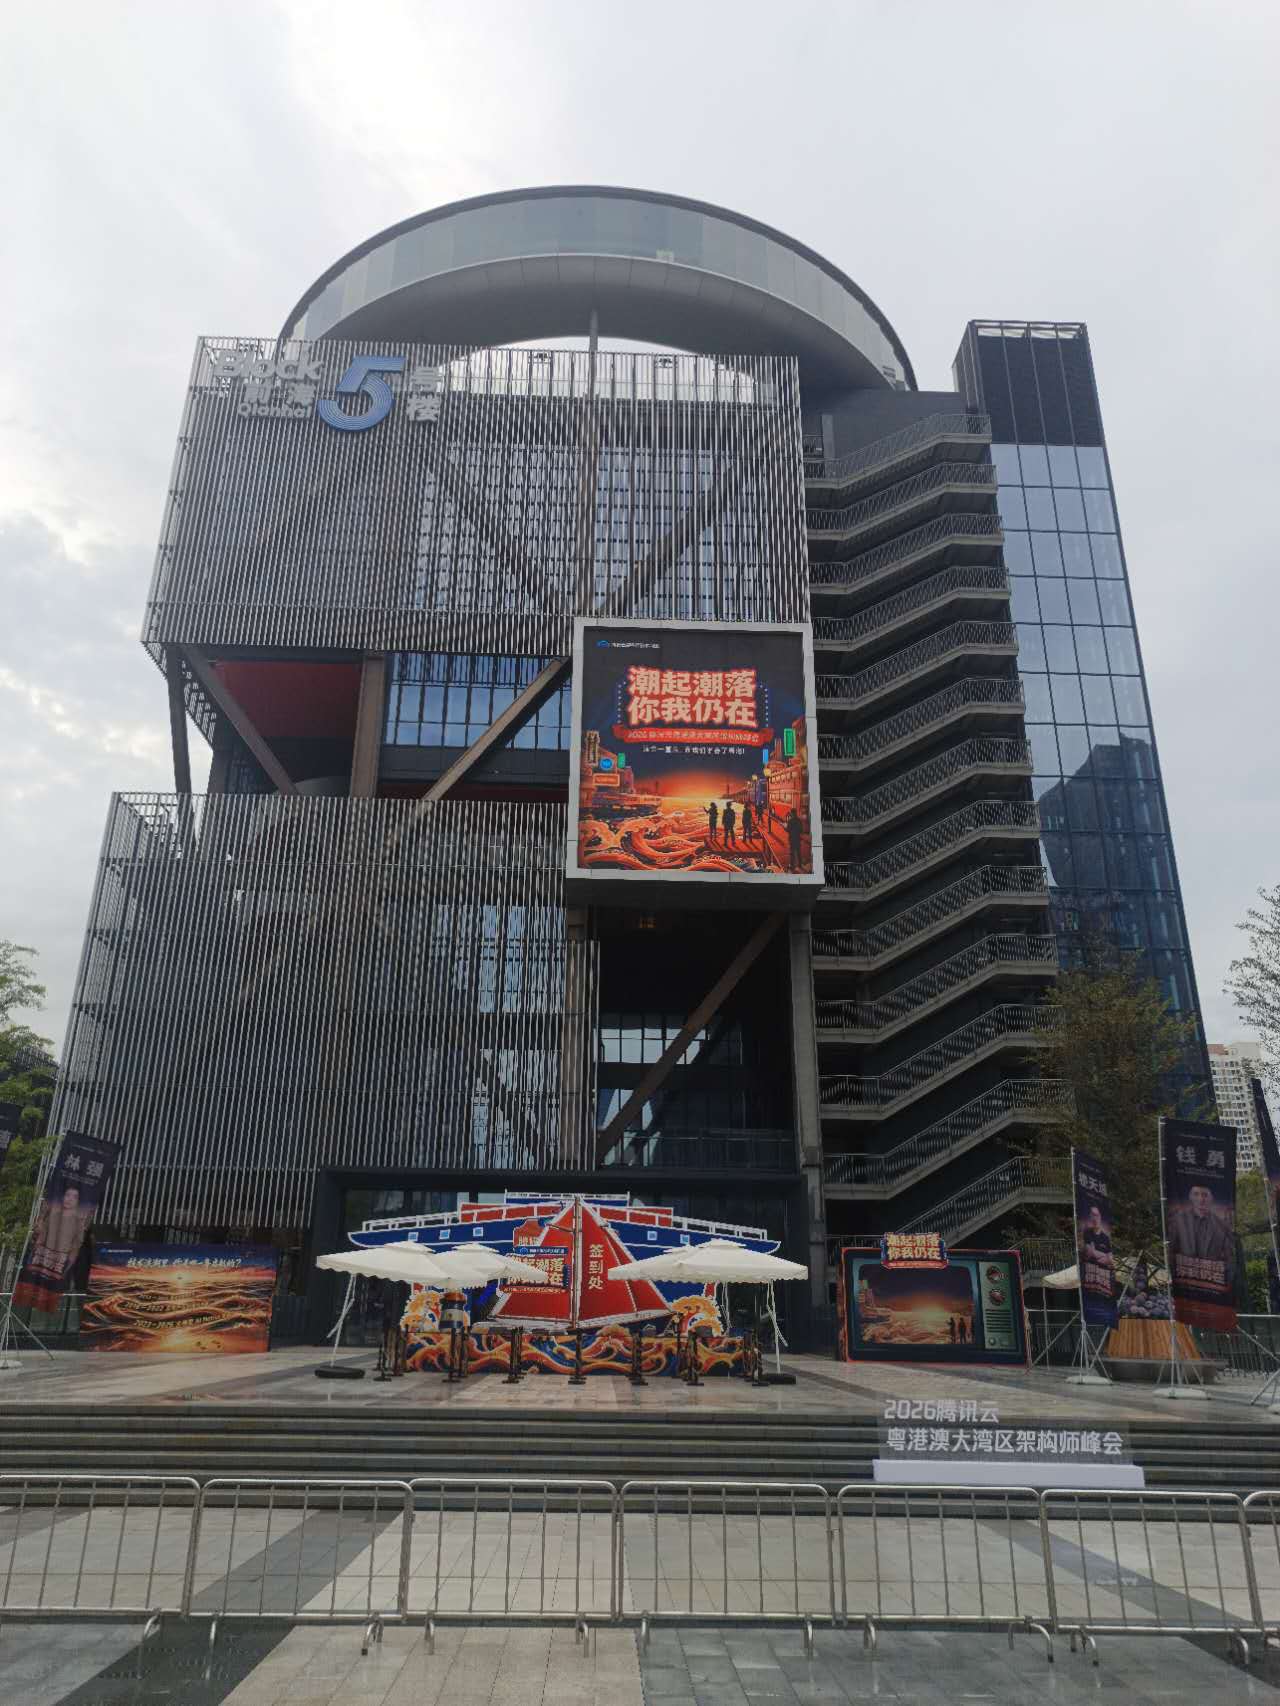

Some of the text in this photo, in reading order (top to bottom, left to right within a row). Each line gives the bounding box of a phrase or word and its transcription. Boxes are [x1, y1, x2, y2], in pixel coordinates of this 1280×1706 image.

[213, 349, 324, 380] Block
[317, 356, 406, 432] 5
[628, 667, 756, 697] 潮起潮落
[629, 696, 758, 728] 你我仍在
[589, 1244, 604, 1290] 签到处
[884, 1400, 999, 1424] 2026腾讯云
[886, 1427, 1124, 1455] 粤港澳大湾区架构师峰会
